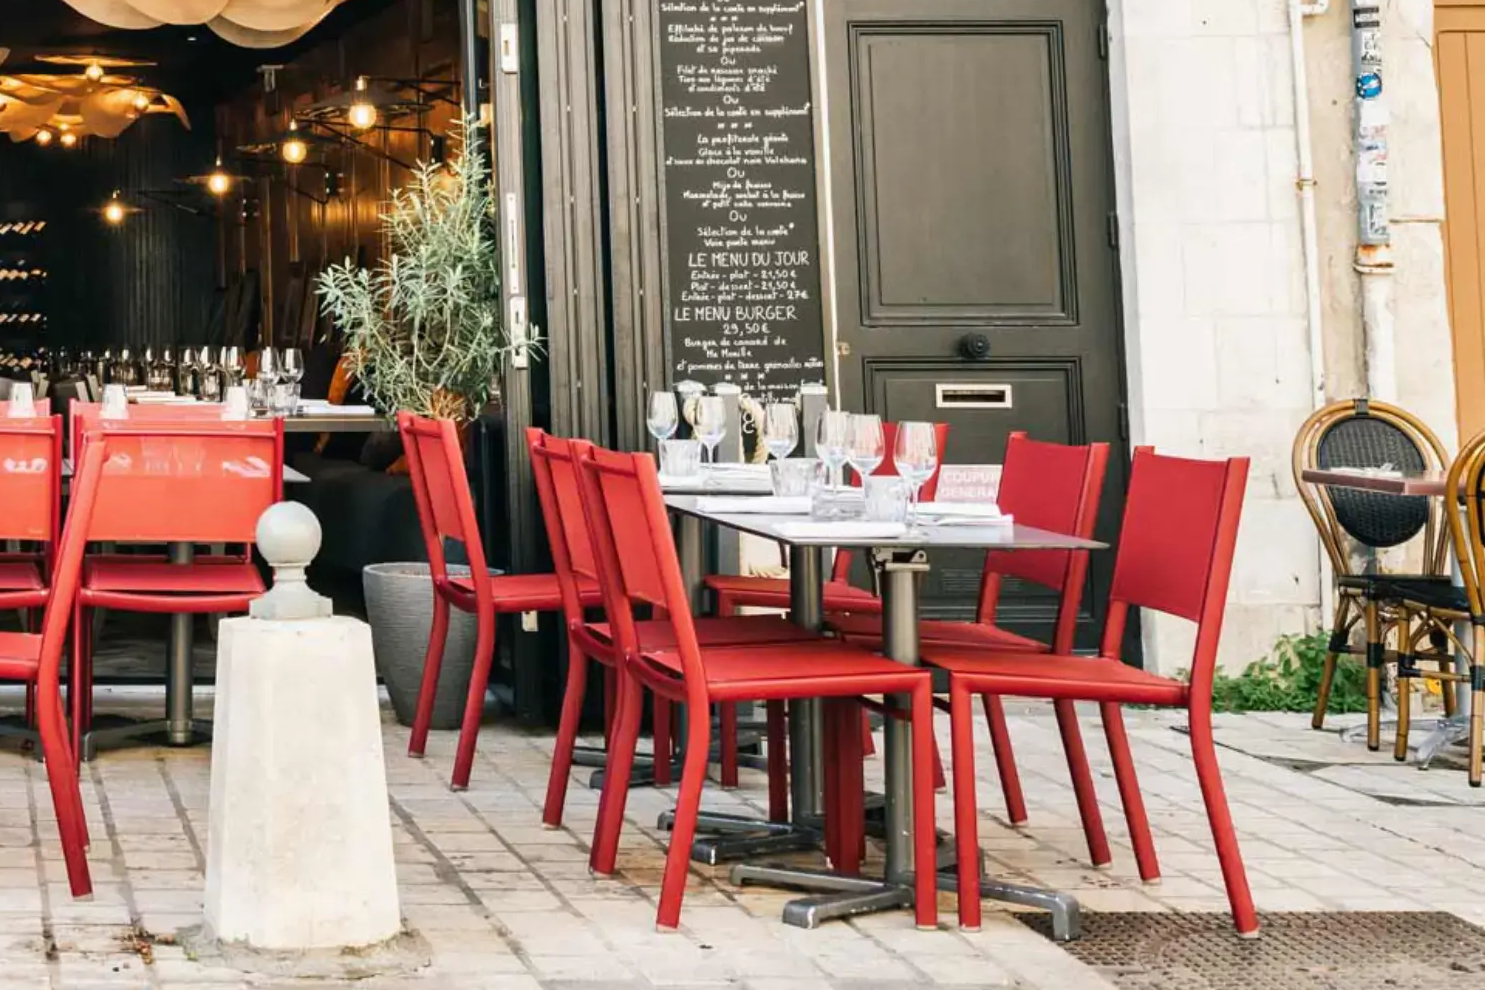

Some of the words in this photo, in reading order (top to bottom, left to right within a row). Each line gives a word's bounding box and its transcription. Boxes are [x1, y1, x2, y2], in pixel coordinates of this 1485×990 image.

[720, 57, 736, 65] Ou
[723, 95, 739, 105] Ou
[727, 167, 745, 179] Ou
[729, 210, 747, 222] Ou
[688, 253, 707, 267] LE
[712, 252, 749, 266] MENU
[752, 253, 770, 266] DU
[774, 250, 810, 266] JOUR
[674, 308, 691, 321] LE
[695, 307, 731, 321] MENU
[735, 305, 798, 321] BURGER
